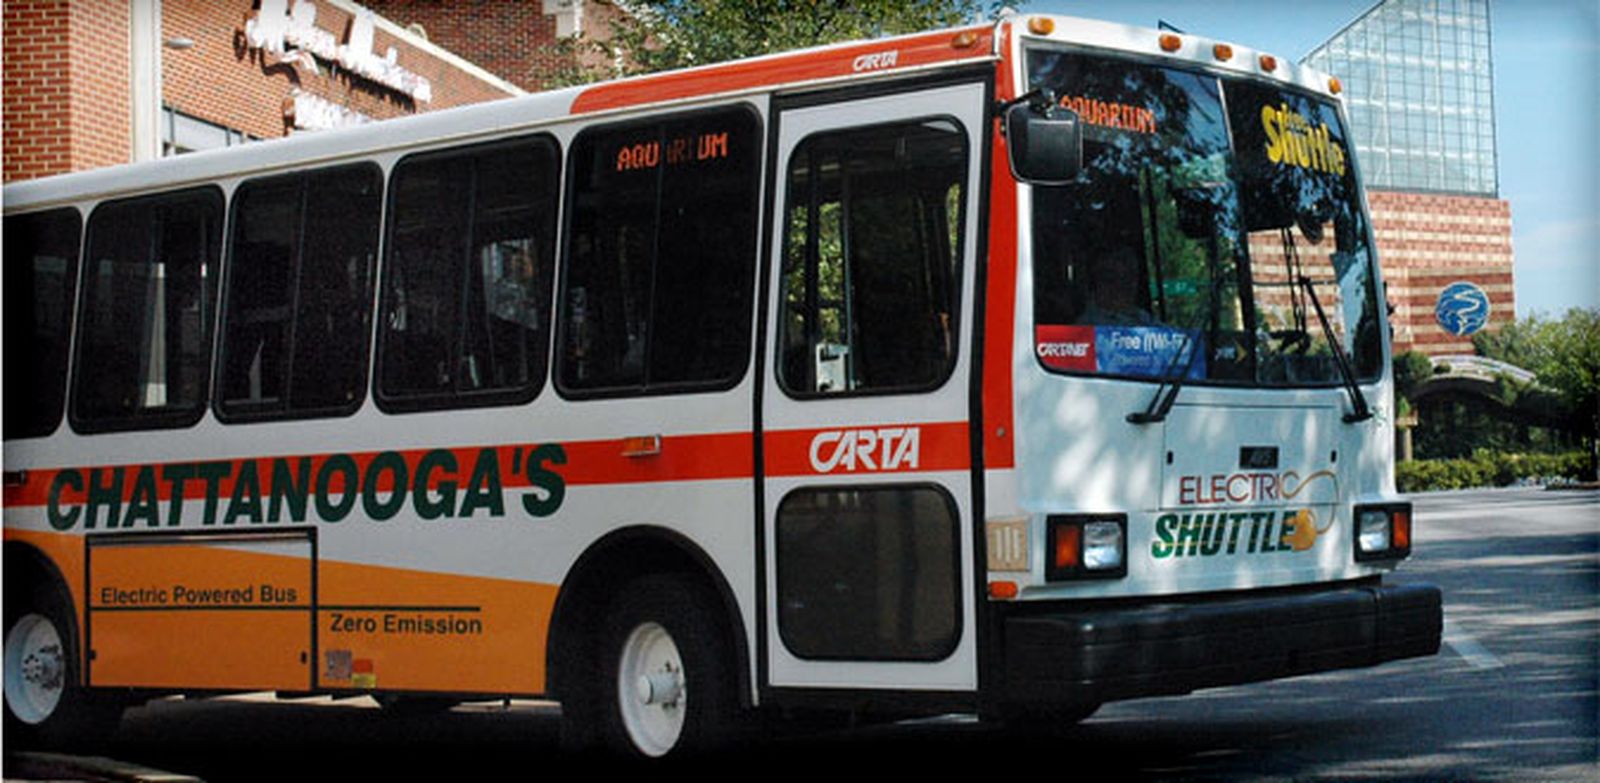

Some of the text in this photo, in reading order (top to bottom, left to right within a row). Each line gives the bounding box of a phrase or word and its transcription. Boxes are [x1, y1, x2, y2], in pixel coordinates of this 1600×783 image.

[853, 49, 898, 71] CARTA
[1111, 331, 1142, 350] Free
[809, 427, 920, 473] CARTA
[46, 442, 568, 529] CHATTANOOGA'S
[1179, 469, 1300, 505] ELECTRIC
[1151, 509, 1299, 559] SHUTTLE
[100, 585, 298, 604] Electric Powered Bus
[330, 613, 482, 635] Zero Emission
